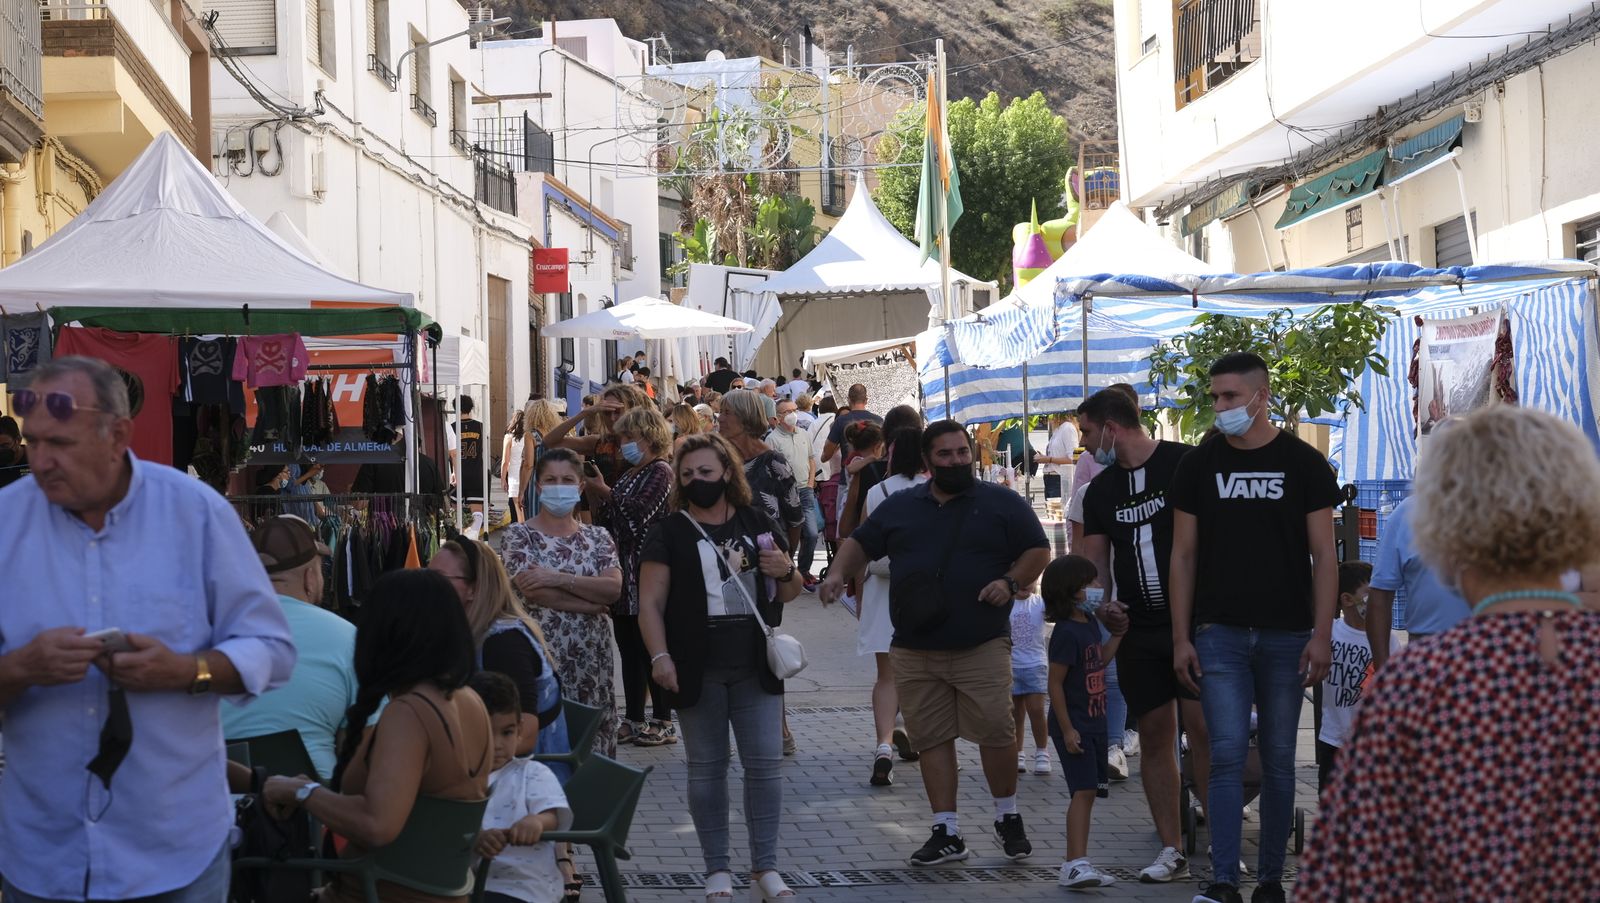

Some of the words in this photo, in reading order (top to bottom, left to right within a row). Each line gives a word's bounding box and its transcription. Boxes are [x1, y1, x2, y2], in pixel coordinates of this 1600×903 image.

[327, 441, 342, 452] DE
[1216, 472, 1285, 500] VANS
[1116, 496, 1166, 524] EDITION
[1331, 640, 1369, 665] EVER
